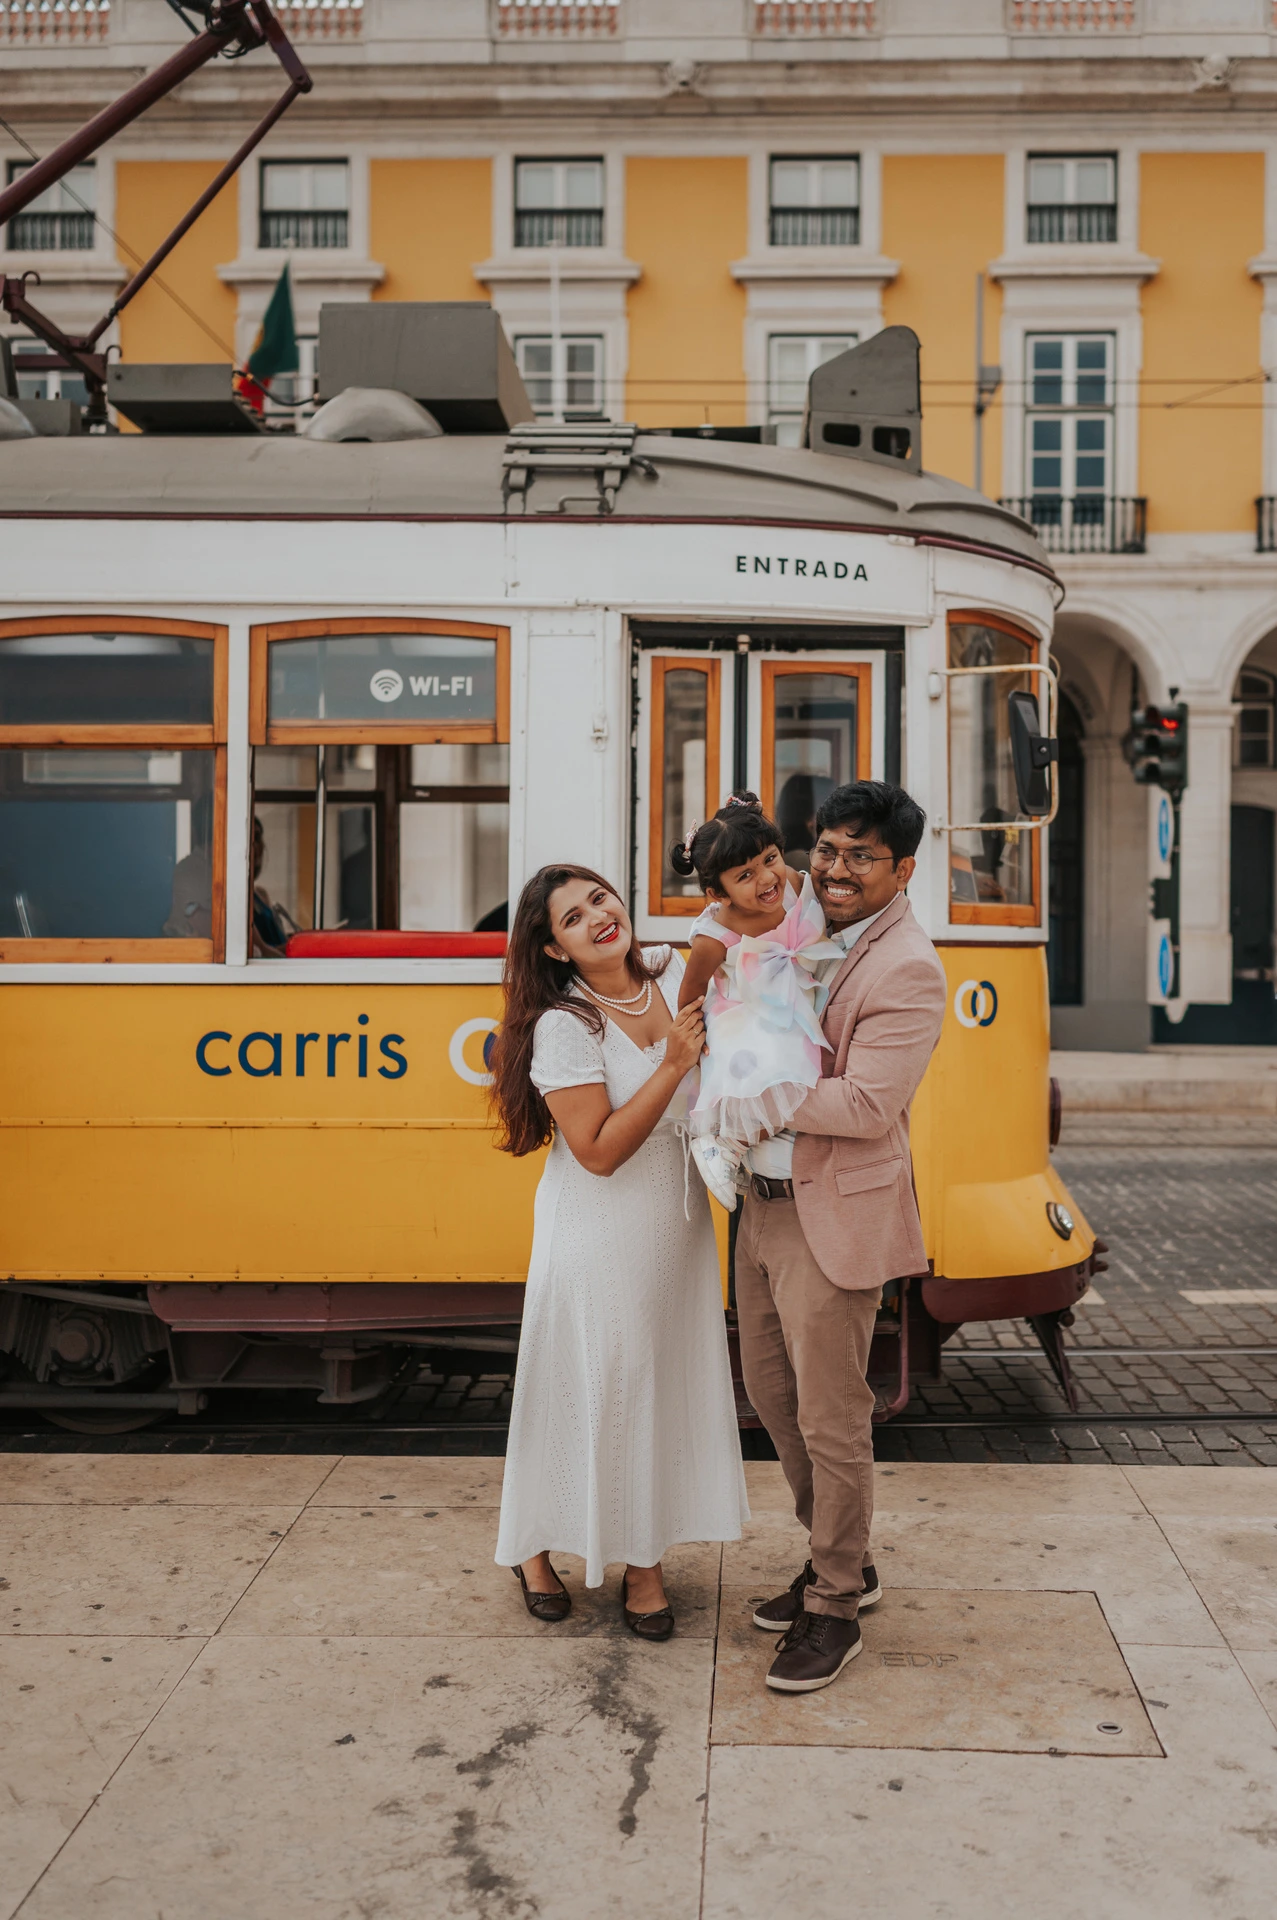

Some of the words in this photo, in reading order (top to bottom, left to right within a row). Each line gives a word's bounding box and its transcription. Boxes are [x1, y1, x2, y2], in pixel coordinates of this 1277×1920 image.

[736, 555, 868, 582] ENTRADA
[408, 676, 473, 696] WI-FI
[195, 1013, 408, 1080] carris
[880, 1651, 959, 1668] EDP
